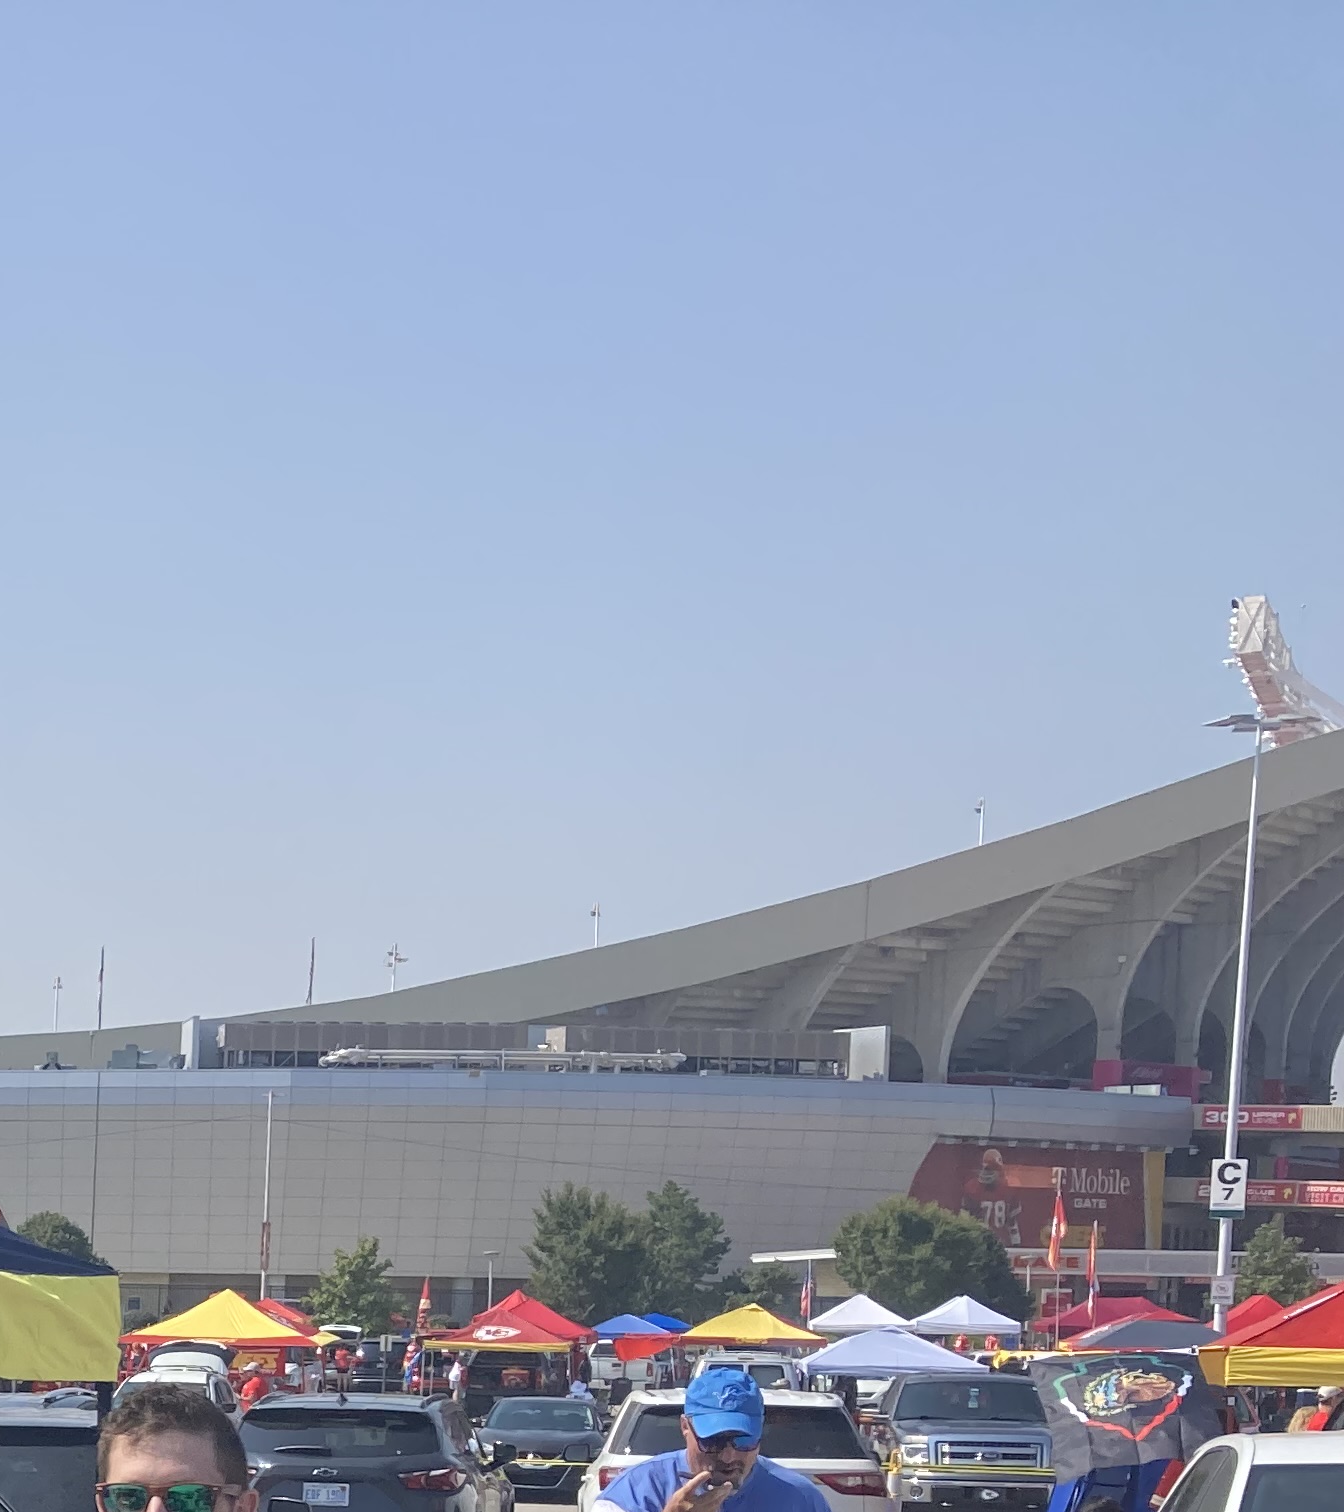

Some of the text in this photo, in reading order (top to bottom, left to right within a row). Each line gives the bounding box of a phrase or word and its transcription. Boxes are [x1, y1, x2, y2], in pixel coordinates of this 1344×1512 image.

[1217, 1162, 1242, 1185] C
[1221, 1188, 1234, 1201] 7
[1074, 1198, 1108, 1209] GATE
